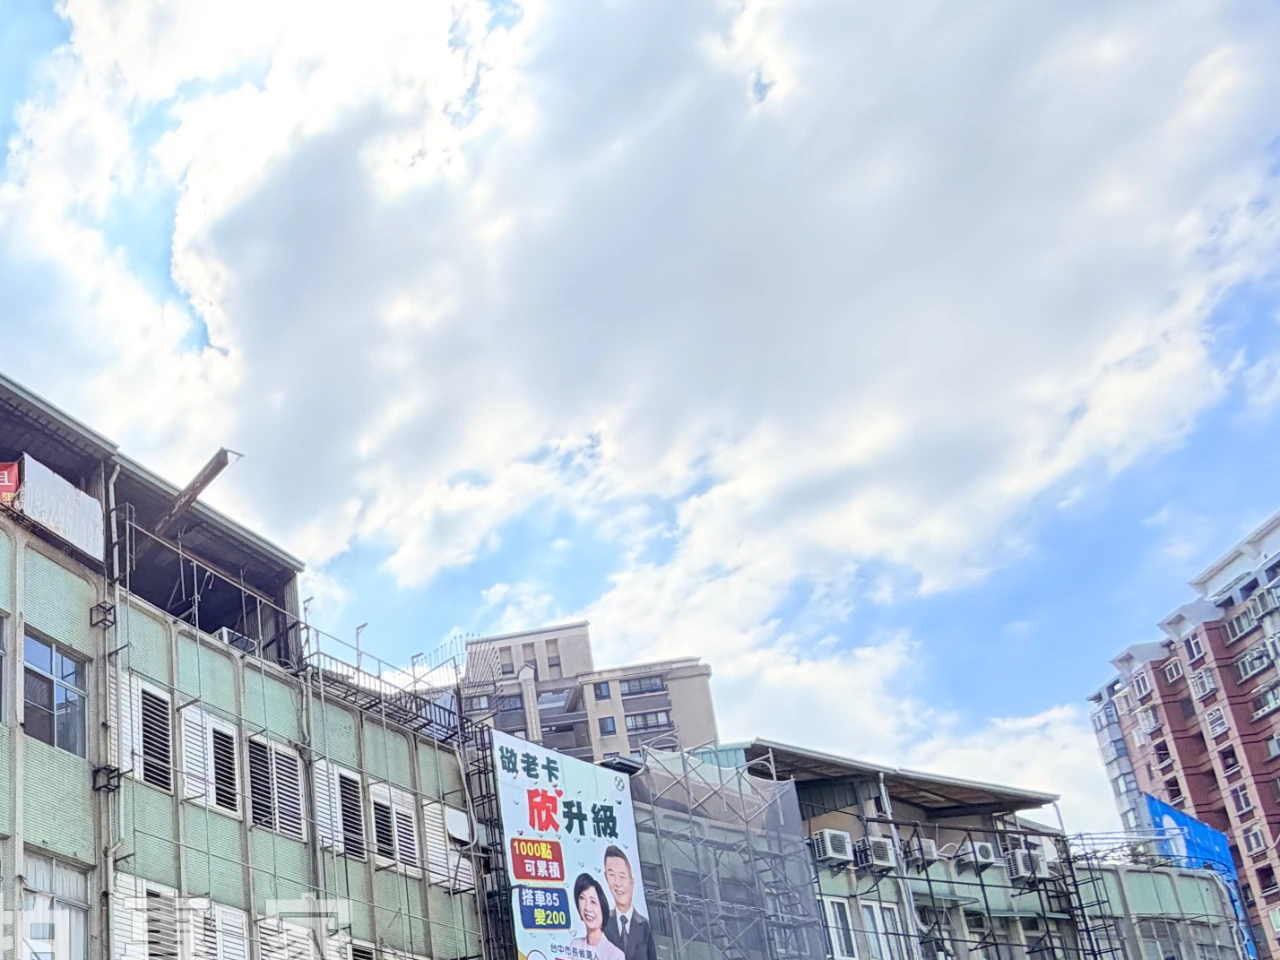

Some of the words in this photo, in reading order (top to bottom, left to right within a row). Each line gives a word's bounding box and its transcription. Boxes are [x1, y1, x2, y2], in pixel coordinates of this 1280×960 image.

[499, 745, 560, 782] 敬老卡
[527, 788, 619, 839] 欣升級
[513, 840, 553, 860] 1000點
[524, 859, 561, 879] 可累積
[521, 888, 560, 907] 搭車85
[534, 908, 566, 926] 變200
